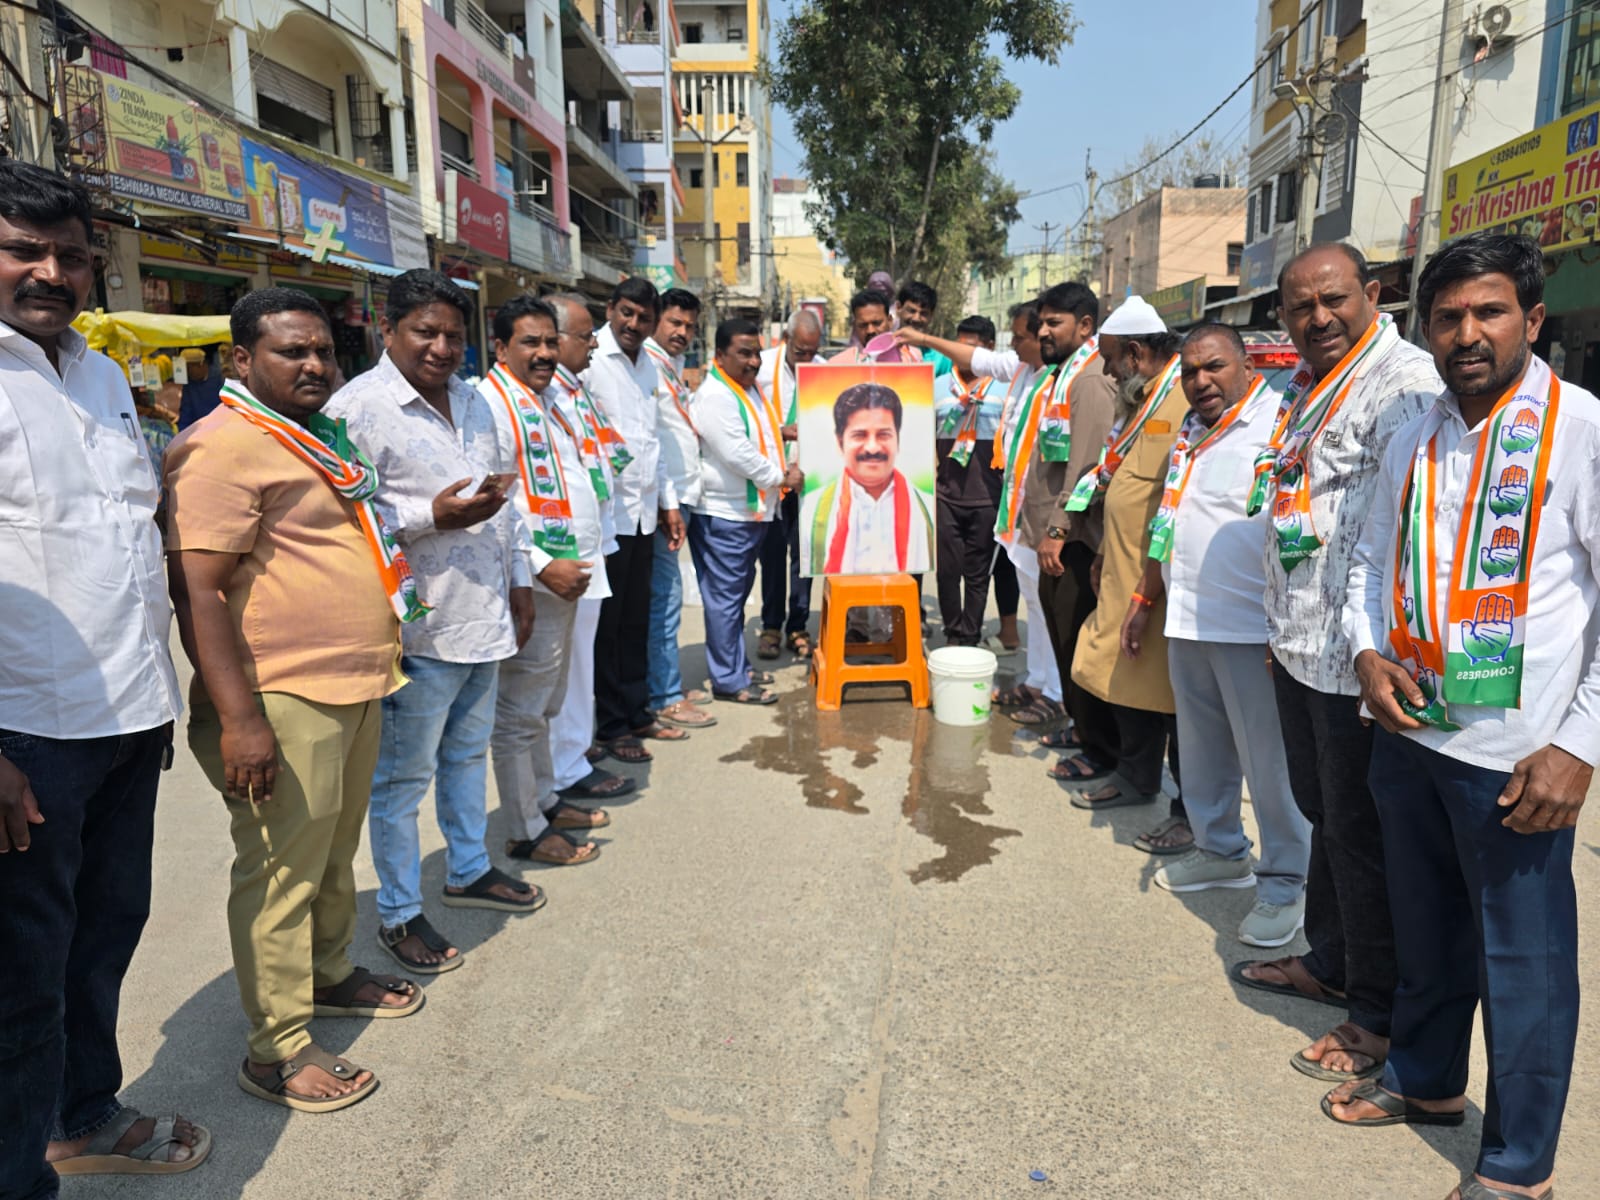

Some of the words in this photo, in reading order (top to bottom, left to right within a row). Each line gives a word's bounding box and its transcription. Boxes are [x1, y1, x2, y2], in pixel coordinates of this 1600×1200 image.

[119, 86, 146, 106] ZINDA
[121, 101, 165, 126] TILISMATH
[156, 185, 191, 206] MEDICAL
[190, 194, 224, 213] GENERAL
[223, 201, 247, 217] STORE
[1449, 197, 1474, 234] Sri
[1477, 175, 1556, 226] Krishna
